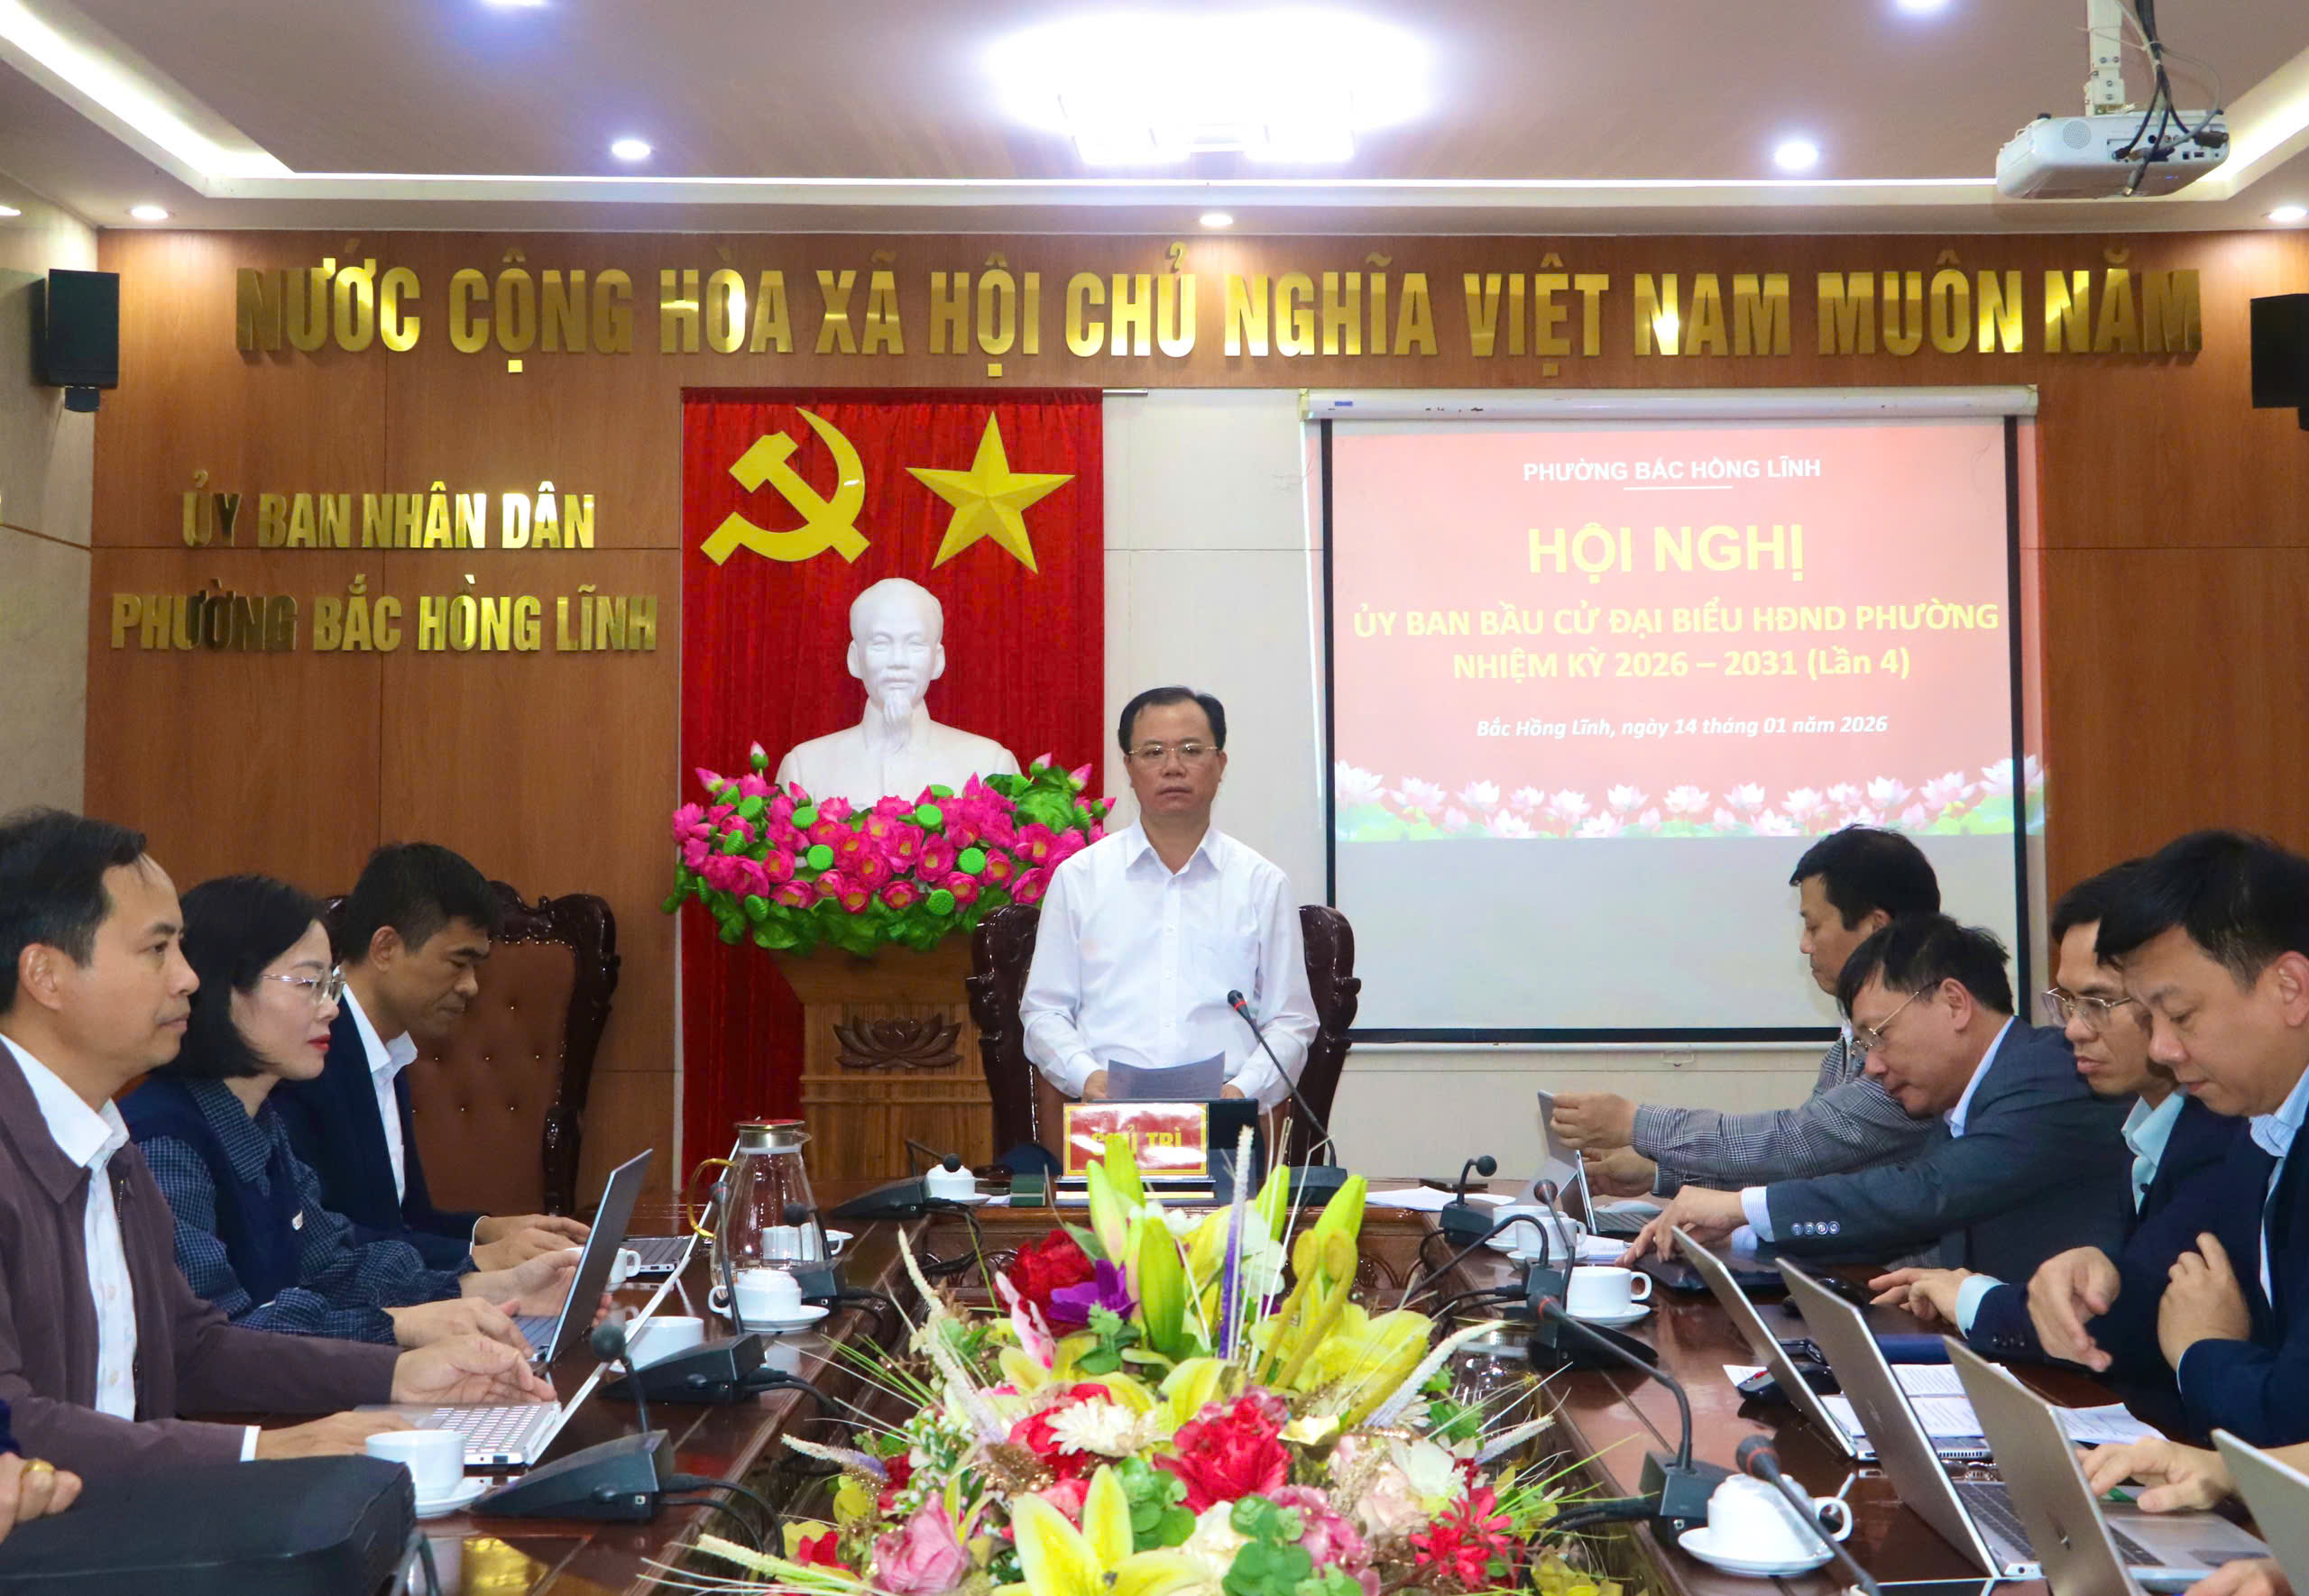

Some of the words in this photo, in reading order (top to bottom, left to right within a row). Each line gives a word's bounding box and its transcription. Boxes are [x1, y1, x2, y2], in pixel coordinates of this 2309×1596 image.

[236, 238, 420, 353] NƯỚC
[450, 247, 632, 372] CỘNG
[659, 246, 794, 353] HÒA
[814, 249, 905, 354] XÃ
[930, 252, 1040, 377] HỘI
[1065, 242, 1198, 357] CHỦ
[1224, 252, 1438, 357] NGHĨA
[1463, 252, 1609, 376] VIỆT
[1634, 272, 1790, 356] NAM
[1817, 249, 2024, 356] MUÔN
[2044, 247, 2203, 353] NĂM
[1523, 457, 1627, 481] PHƯỜNG
[1767, 454, 1820, 477] LĨNH
[183, 469, 243, 548] ỦY
[258, 493, 351, 548] BAN
[362, 481, 487, 549] NHÂN
[501, 481, 595, 549] DÂN
[1528, 521, 1632, 583] HỘI
[1654, 523, 1804, 582] NGHỊ
[111, 578, 298, 650] PHƯỜNG
[313, 573, 402, 651] BẮC
[419, 573, 541, 651] HỒNG
[557, 584, 658, 651] LĨNH
[1354, 602, 1396, 637] ỦY
[1407, 610, 1471, 636] BAN
[1481, 600, 1544, 636] BẦU
[1554, 599, 1601, 635] CỬ
[1609, 609, 1662, 639] ĐẠI
[1672, 596, 1743, 633] BIỂU
[1752, 606, 1846, 631] HĐND
[1856, 598, 1999, 630] PHƯỜNG
[1453, 647, 1558, 683] NHIỆM
[1568, 646, 1605, 677] KỲ
[1615, 651, 1689, 677] 2026
[1724, 650, 1798, 675] 2031
[1807, 645, 1872, 680] (Lần
[1881, 647, 1910, 679] 4)
[1476, 716, 1511, 737] Bắc
[1516, 717, 1567, 739] Hồng
[1572, 718, 1615, 738] Lĩnh,
[1622, 718, 1670, 739] ngày
[1674, 718, 1697, 735] 14
[1702, 716, 1759, 738] tháng
[1763, 718, 1787, 733] 01
[1792, 715, 1835, 733] năm
[1840, 716, 1889, 732] 2026
